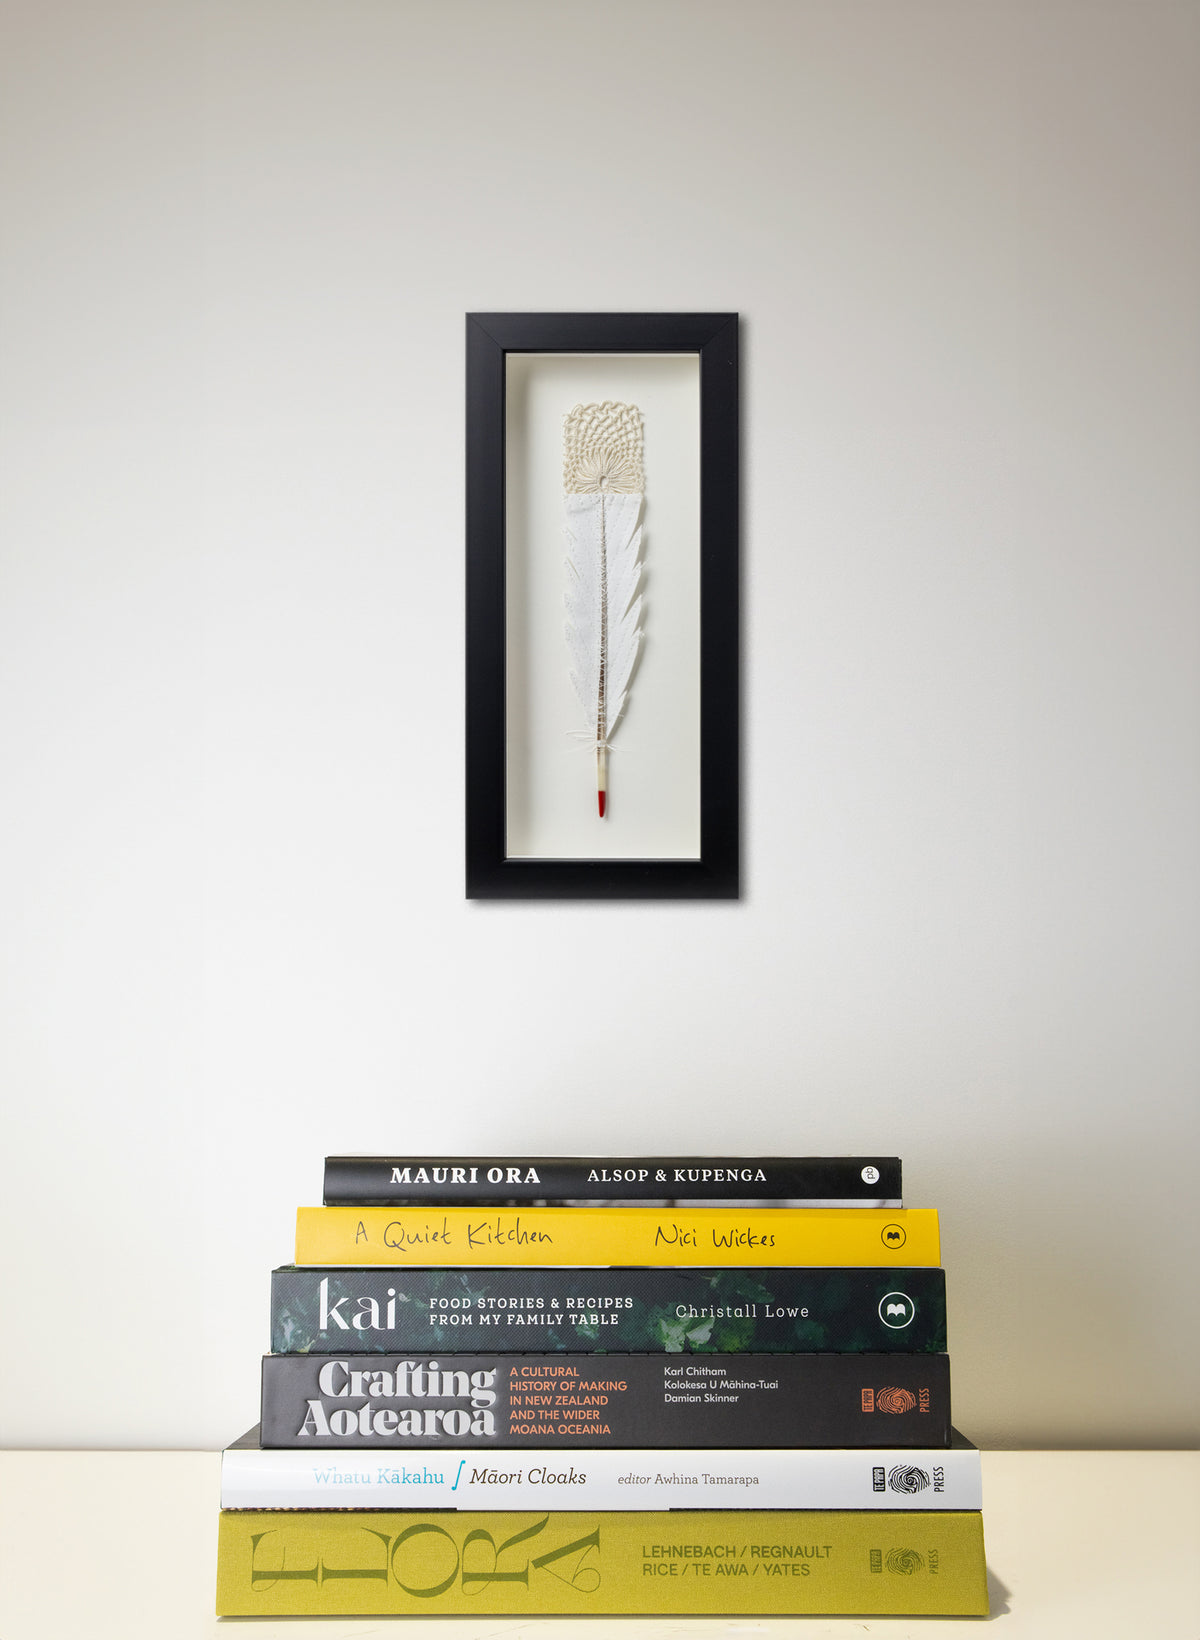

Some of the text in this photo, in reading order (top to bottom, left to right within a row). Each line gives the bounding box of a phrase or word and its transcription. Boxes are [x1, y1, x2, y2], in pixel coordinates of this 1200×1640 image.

[390, 1168, 540, 1183] MAURI ORA
[587, 1169, 767, 1182] ALSOP & KUPENGA
[355, 1217, 552, 1251] A Quiet Kitchen
[655, 1224, 776, 1248] Nici Wickes
[319, 1277, 396, 1331] kai
[430, 1298, 633, 1309] FOOD STORIES & RECIPES
[676, 1303, 809, 1318] Christall Lowe
[430, 1314, 619, 1325] FROM MY FAMILY TABLE
[510, 1367, 579, 1377] A CULTURAL
[664, 1366, 727, 1376] Karl Chitham
[319, 1361, 497, 1408] Crafting
[510, 1381, 627, 1391] HISTORY OF MAKING
[664, 1380, 779, 1390] Kolokesa U Māhina-Tuai
[510, 1395, 609, 1405] IN NEW ZEALAND
[664, 1393, 739, 1403] Damian Skinner
[919, 1388, 930, 1413] PRESS
[298, 1400, 497, 1437] Aotearoa
[510, 1410, 600, 1420] AND THE WIDER
[510, 1424, 611, 1435] MOANA OCEANIA
[314, 1467, 371, 1484] Whatu
[377, 1467, 445, 1484] Kākahu
[469, 1469, 522, 1485] Māori
[528, 1467, 587, 1485] Cloaks
[617, 1473, 760, 1487] editor Awhina Tamarapa
[933, 1466, 945, 1493] PRESS
[250, 1511, 601, 1599] FLORA
[643, 1545, 736, 1558] LEHNEBACH
[751, 1545, 832, 1559] REGNAULT
[928, 1549, 939, 1575] PRESS
[643, 1563, 678, 1576] RICE
[693, 1563, 711, 1576] TE
[715, 1563, 749, 1576] AWA
[763, 1563, 810, 1577] YATES
